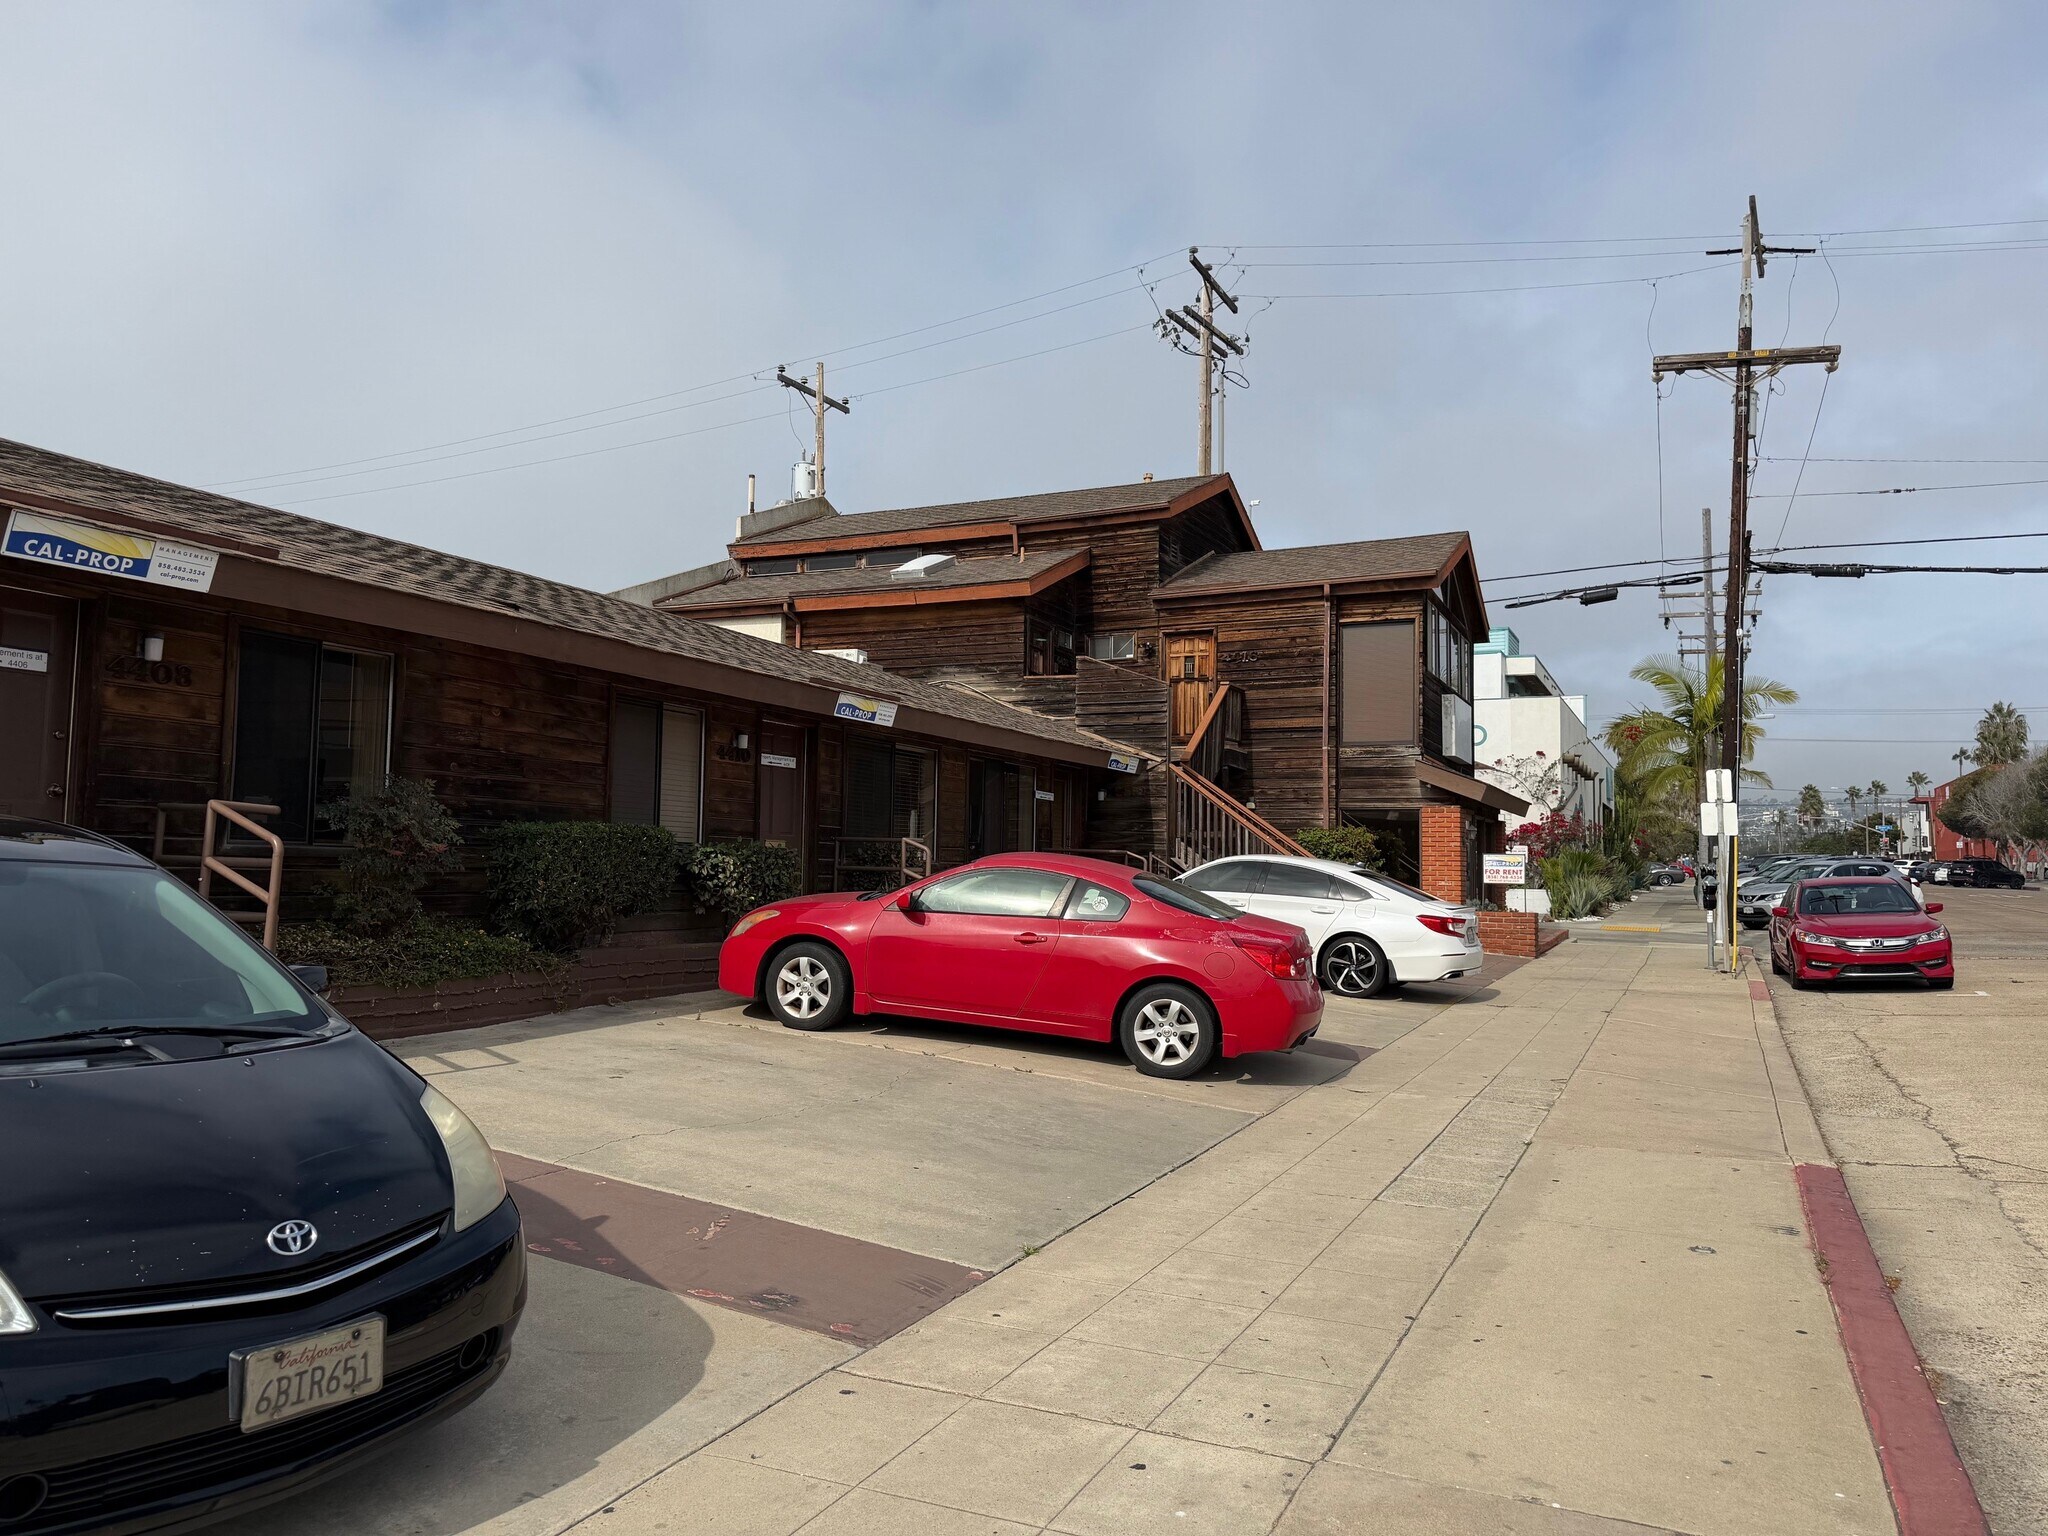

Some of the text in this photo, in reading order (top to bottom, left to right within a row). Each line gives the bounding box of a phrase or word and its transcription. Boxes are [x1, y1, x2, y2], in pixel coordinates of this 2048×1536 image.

[24, 539, 134, 572] CAL-PROP
[159, 546, 214, 562] MANAGEMENT
[160, 571, 199, 583] cal-prop.com
[8, 659, 28, 669] 4406
[840, 706, 872, 720] CAL-PROP
[279, 1339, 360, 1370] California
[254, 1351, 373, 1415] 6BIR651
